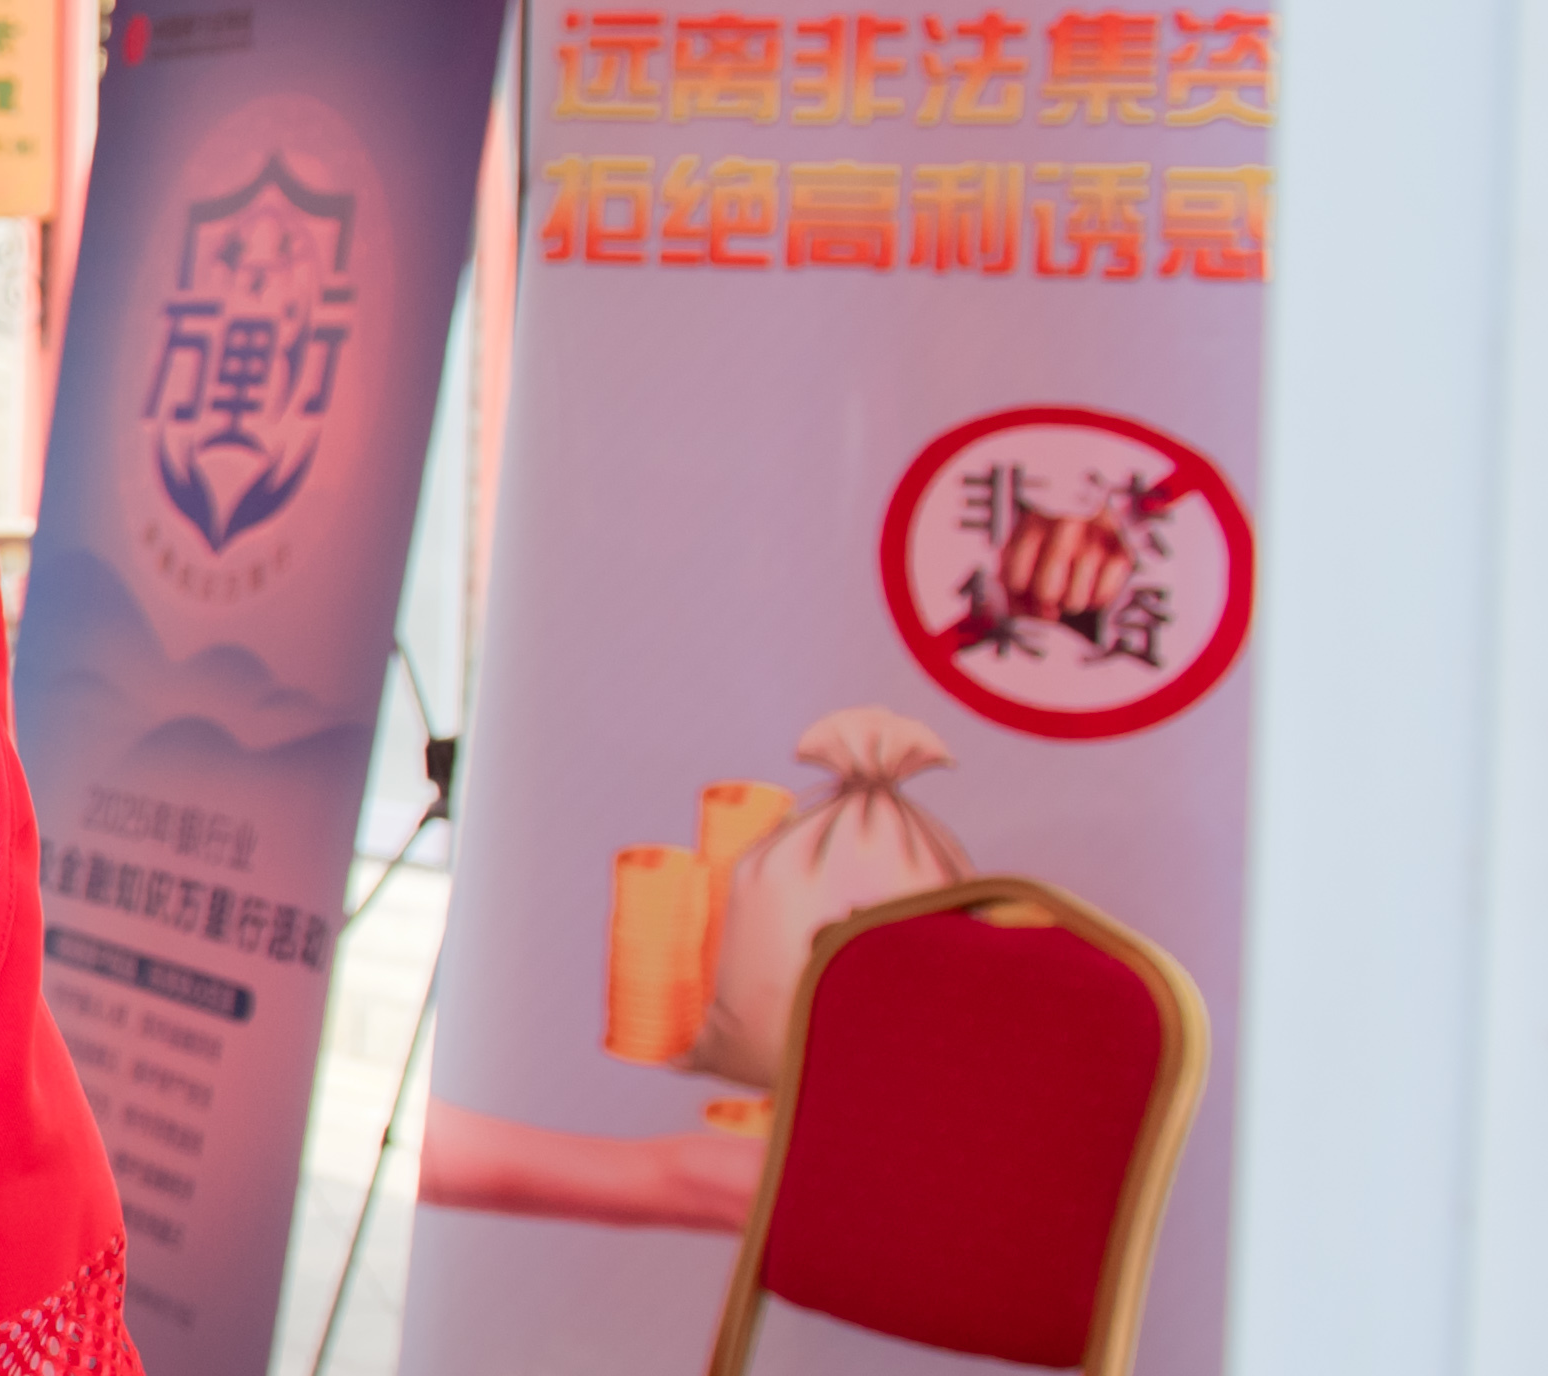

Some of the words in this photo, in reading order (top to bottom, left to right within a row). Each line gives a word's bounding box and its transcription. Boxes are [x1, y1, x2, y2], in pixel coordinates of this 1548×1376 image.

[551, 11, 1277, 129] 远离非法集资
[542, 153, 1273, 283] 拒绝高利诱惑
